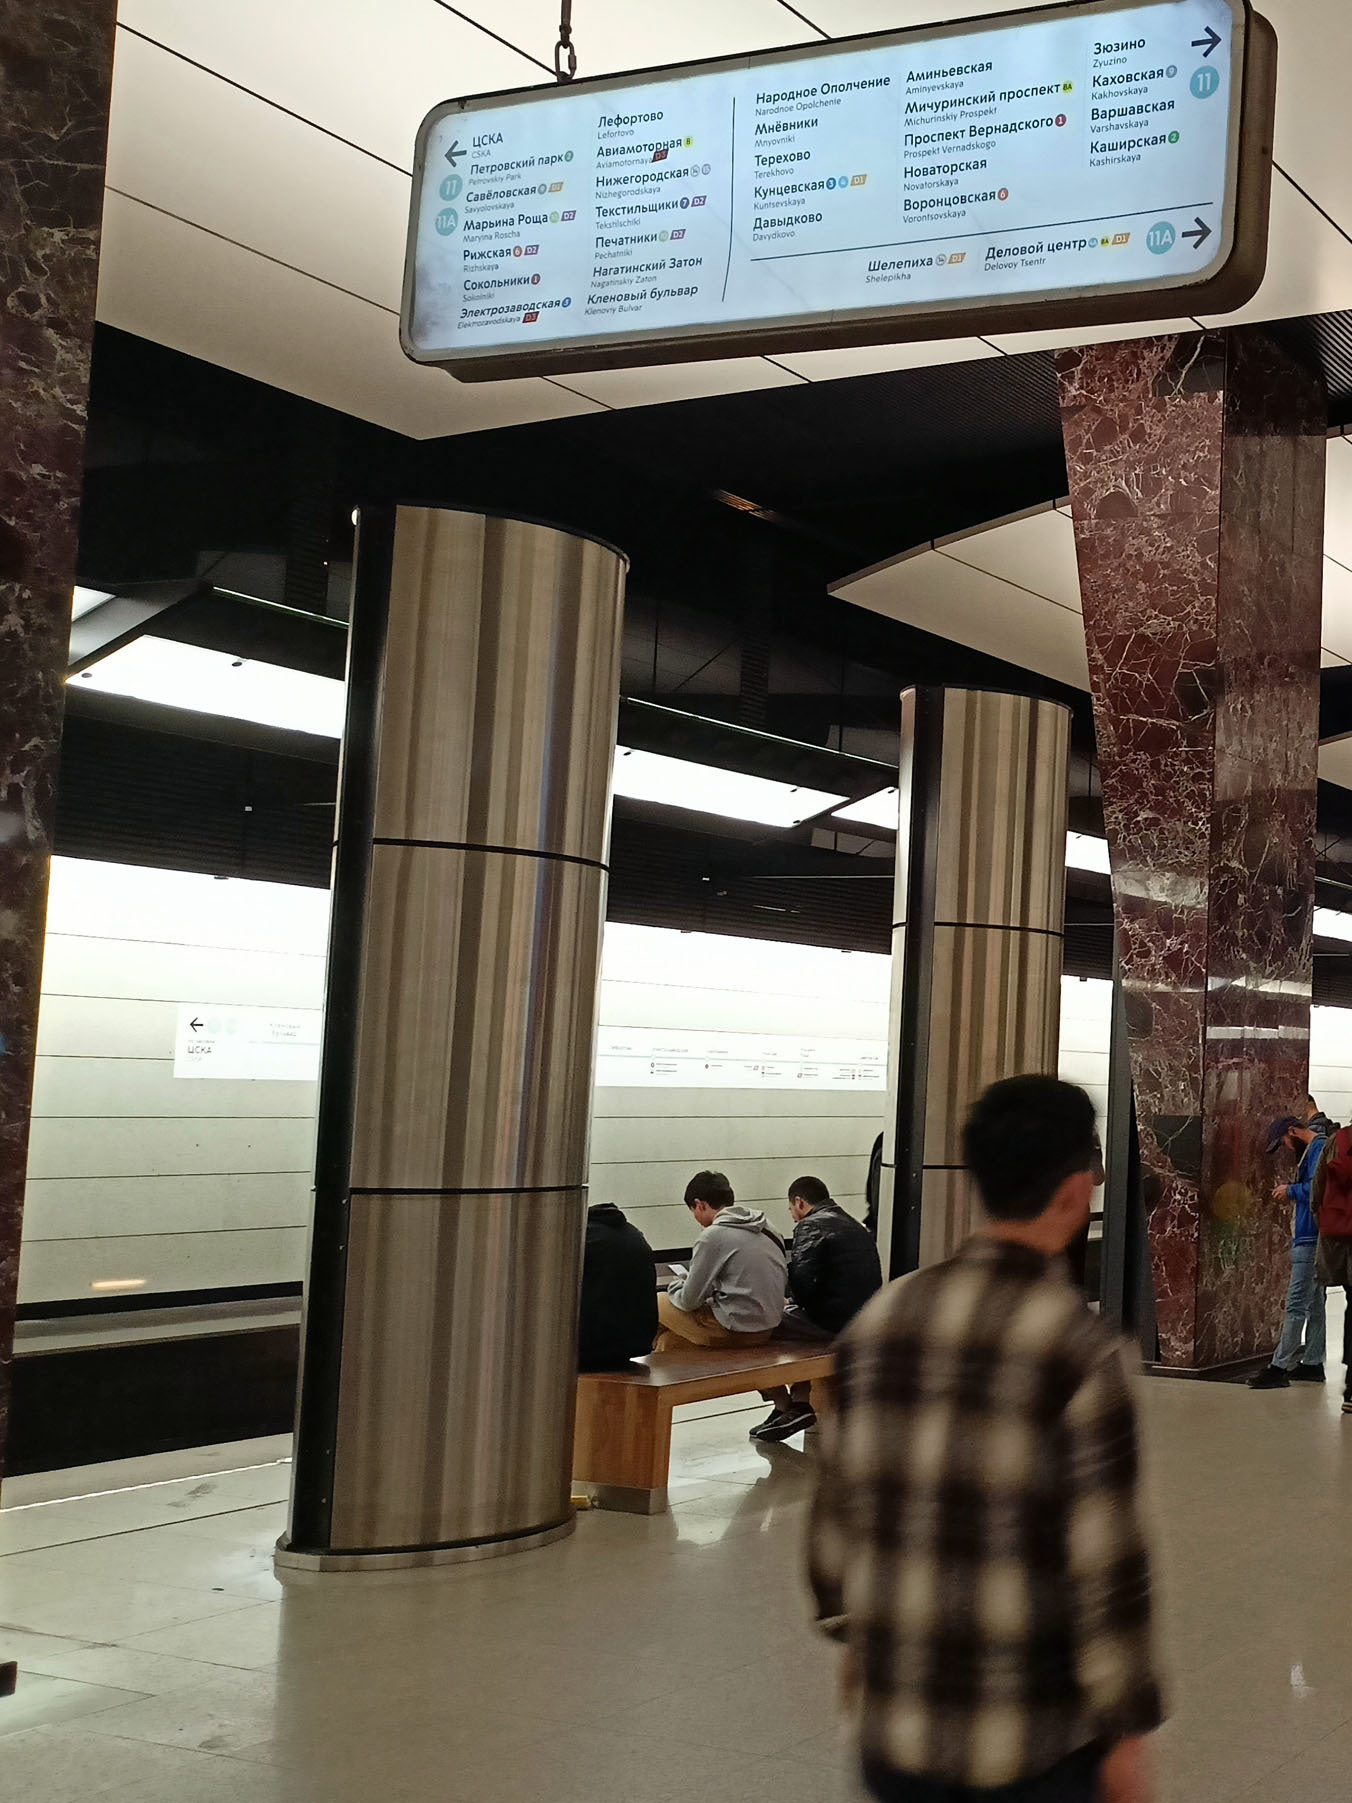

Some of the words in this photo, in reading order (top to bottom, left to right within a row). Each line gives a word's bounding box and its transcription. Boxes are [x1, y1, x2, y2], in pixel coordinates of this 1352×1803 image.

[1094, 39, 1146, 55] Зюзино
[1093, 56, 1128, 69] Zyuzino
[906, 61, 993, 84] Аминьевская
[1093, 68, 1164, 88] Каховская
[756, 86, 818, 105] Народное
[821, 76, 891, 96] Ополчение
[906, 80, 964, 96] Aminyevskaya
[1197, 72, 1213, 92] 11
[905, 94, 996, 115] Мичуринский
[1000, 83, 1060, 104] проспект
[1092, 85, 1149, 101] Kakhovskaya
[756, 104, 794, 116] Narodnoe
[796, 97, 842, 111] Opolchenie
[1091, 101, 1175, 121] Варшавская
[599, 111, 664, 128] Лефортово
[904, 113, 958, 127] Michurinskiy
[960, 107, 997, 121] Prospekt
[598, 129, 634, 140] Lefortovo
[755, 118, 819, 135] Мнёвники
[904, 128, 966, 148] Проспект
[970, 116, 1054, 138] Вернадского
[1091, 119, 1149, 133] Varshavskaya
[472, 133, 503, 149] ЦСКА
[597, 137, 682, 158] Авиамоторная
[754, 136, 796, 148] Mnyovniki
[904, 147, 940, 160] Prospekt
[942, 139, 997, 155] Vernadskogo
[1090, 134, 1167, 154] Каширская
[472, 150, 491, 159] CSKA
[755, 151, 811, 168] Терехово
[1090, 153, 1141, 167] Kashirskaya
[470, 157, 535, 176] Петровский
[538, 153, 564, 167] парк
[904, 159, 987, 179] Новаторская
[469, 175, 504, 187] Petrovskiy
[506, 173, 522, 182] Park
[597, 168, 689, 188] Нижегородская
[754, 167, 794, 180] Terekhovo
[445, 180, 457, 195] 11
[596, 187, 661, 199] Nizhegorodskaya
[754, 181, 825, 200] Кунцевская
[904, 178, 959, 192] Novatorskaya
[467, 186, 536, 203] Савёловская
[904, 189, 996, 212] Воронцовская
[465, 202, 515, 214] Savyolovskaya
[596, 199, 679, 218] Текстильщики
[694, 197, 705, 206] D2
[754, 198, 805, 211] Kuntsevskaya
[464, 217, 515, 232] Марьина
[518, 213, 548, 226] Роща
[564, 212, 574, 220] D2
[753, 213, 823, 232] Давыдково
[903, 210, 966, 224] Vorontsovskaya
[463, 233, 493, 244] Maryina
[494, 231, 521, 239] Roscha
[596, 232, 658, 248] Печатники
[672, 231, 684, 239] D2
[753, 230, 795, 242] Davydkovo
[464, 247, 512, 261] Рижская
[526, 246, 538, 254] D2
[985, 241, 1044, 261] Деловой
[1048, 238, 1087, 255] центр
[464, 263, 499, 273] Rizhskaya
[593, 259, 666, 278] Нагатинский
[669, 256, 703, 269] Затон
[868, 257, 933, 272] Шелепиха
[984, 259, 1019, 271] Delovoy
[1021, 257, 1046, 267] Tsentr
[464, 277, 530, 291] Сокольники
[635, 275, 657, 284] Zaton
[866, 273, 912, 284] Shelepikha
[588, 289, 647, 305] Кленовый
[651, 285, 699, 300] бульвар
[460, 299, 560, 319] Электрозаводская
[188, 1046, 212, 1055] ЦСКА
